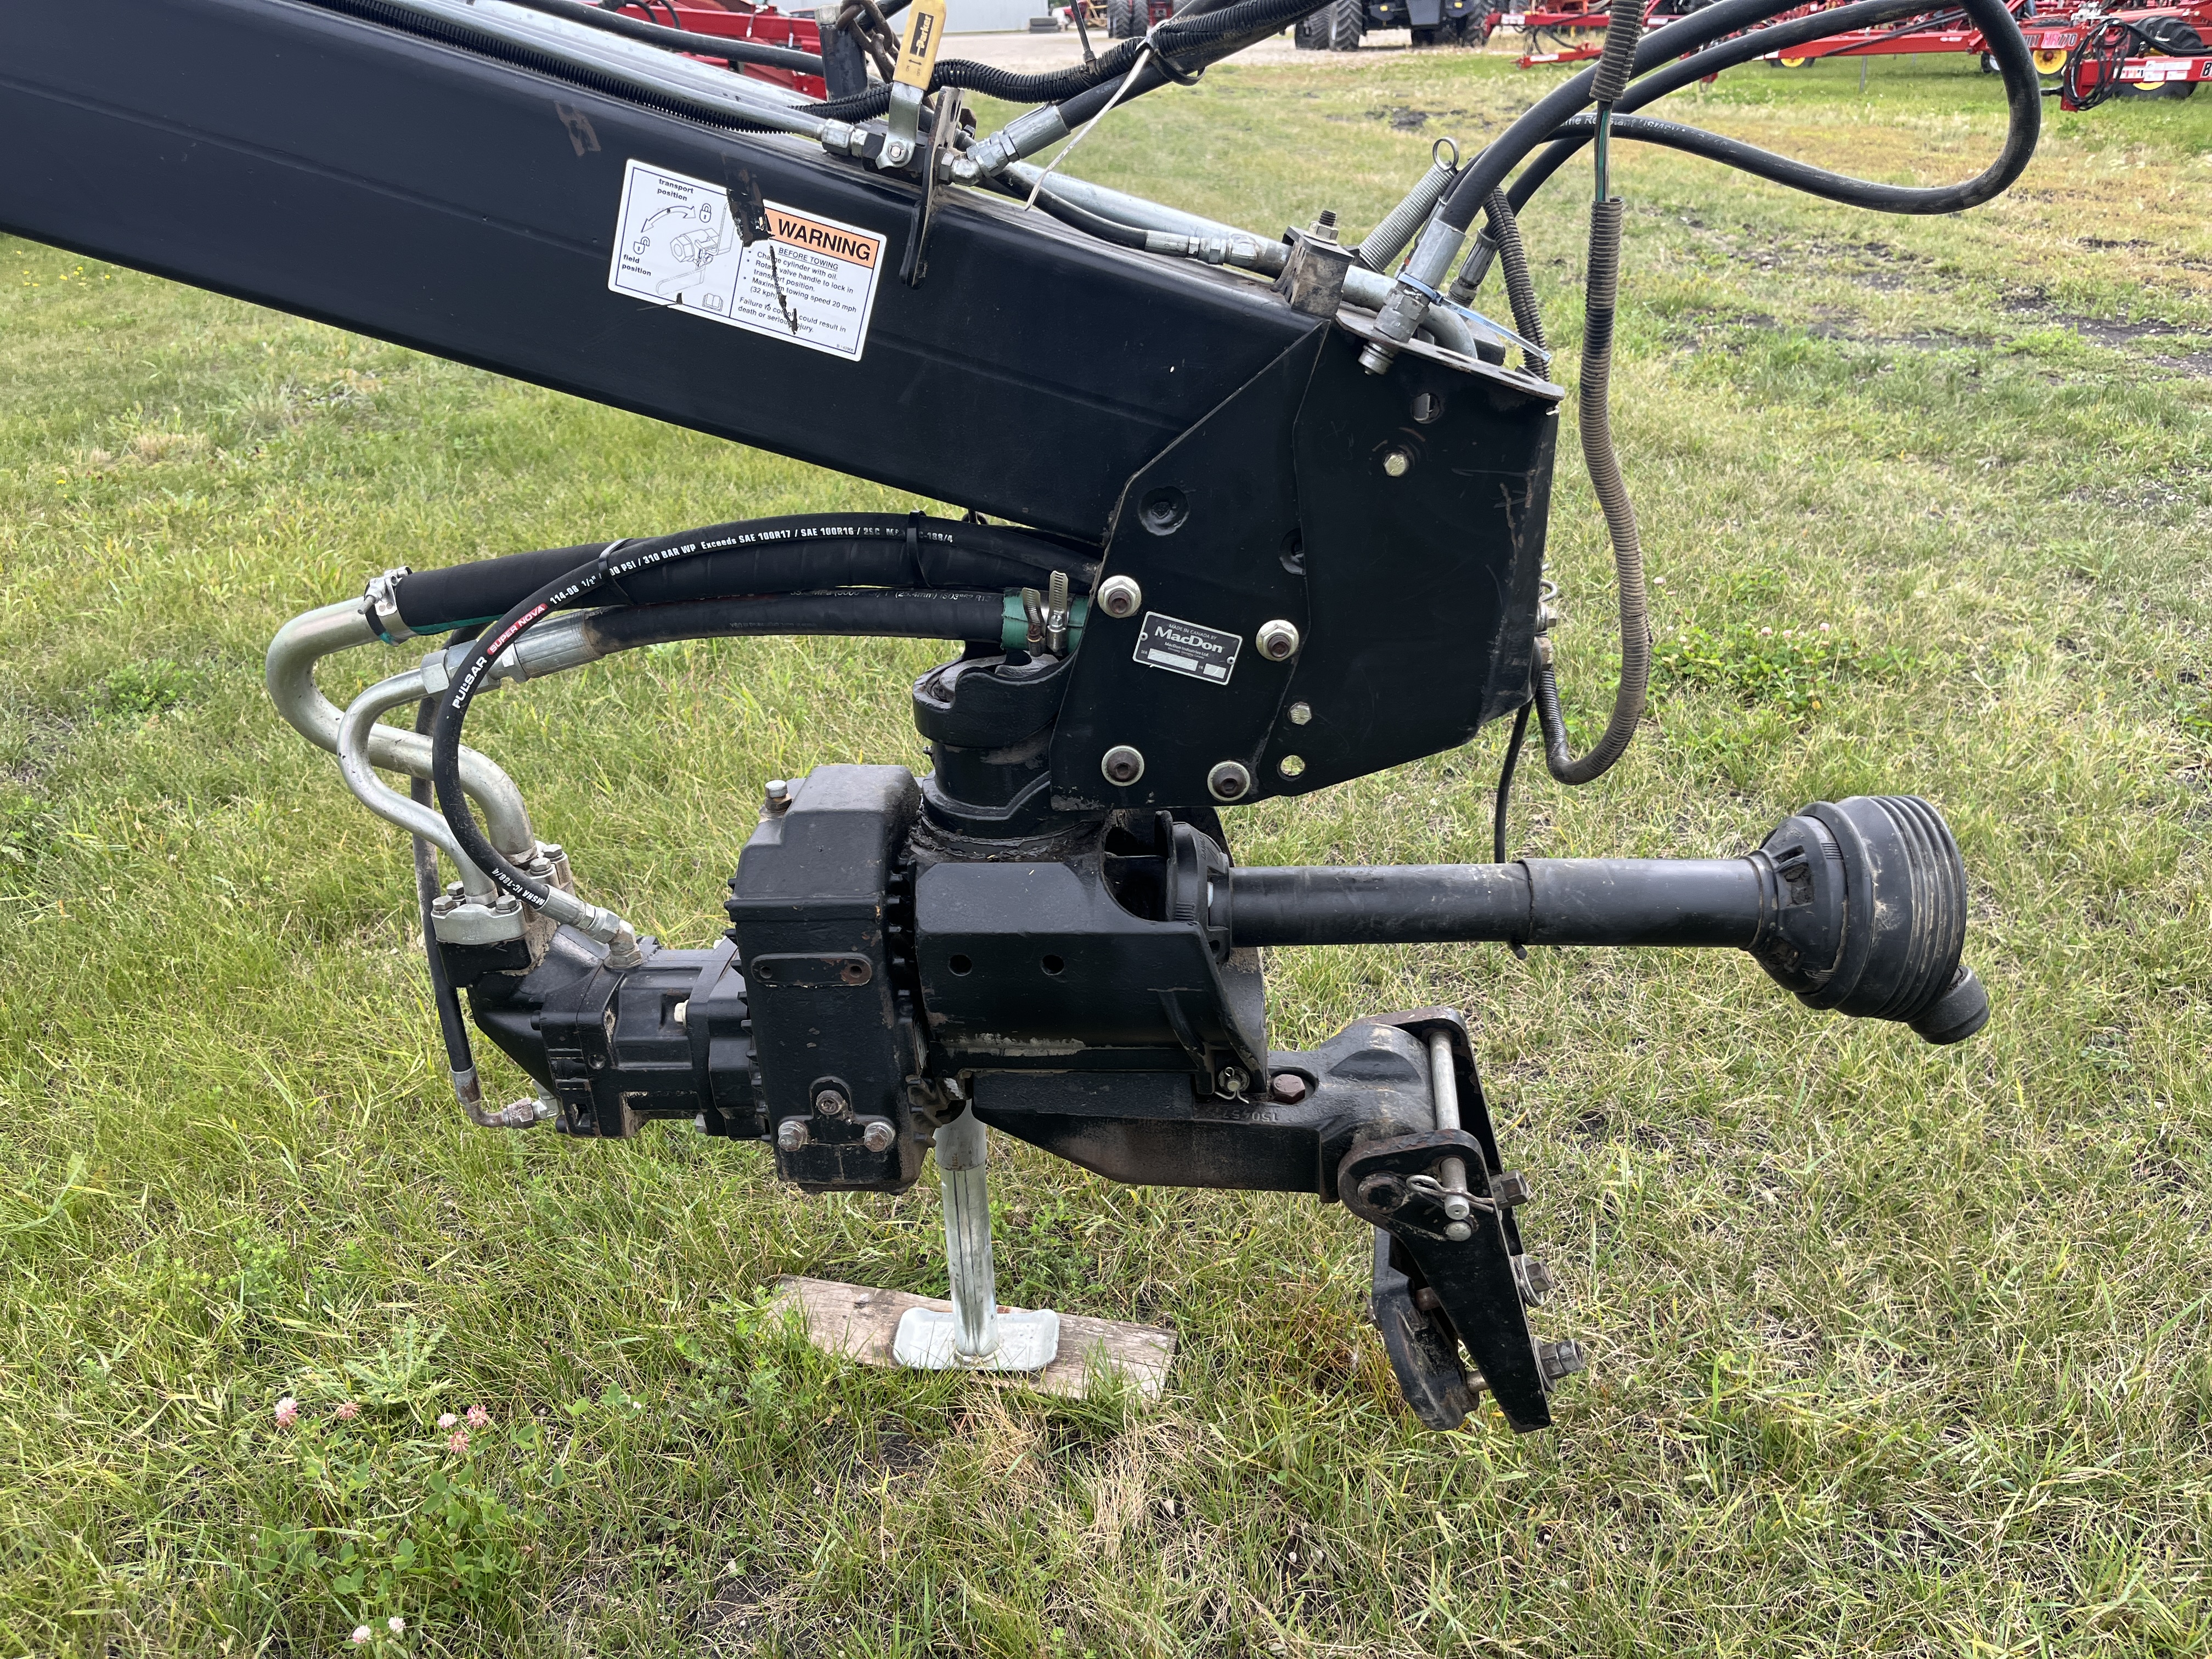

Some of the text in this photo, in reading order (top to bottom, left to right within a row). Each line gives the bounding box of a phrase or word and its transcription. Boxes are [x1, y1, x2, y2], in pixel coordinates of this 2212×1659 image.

[916, 15, 932, 56] Parker
[657, 188, 687, 201] position
[659, 178, 693, 194] transport
[778, 218, 871, 261] WARNING
[622, 263, 651, 276] position
[623, 254, 640, 263] field
[757, 251, 781, 263] Chage
[783, 260, 811, 272] cylinder
[812, 268, 826, 277] with
[779, 247, 838, 270] BEFORE TOWING
[752, 277, 785, 291] Maximm
[786, 287, 809, 300] towing
[810, 295, 831, 305] speed
[780, 268, 797, 277] valve
[799, 273, 821, 284] handle
[831, 282, 845, 292] lock
[786, 279, 815, 292] position.
[738, 306, 757, 316] death
[740, 297, 763, 308] Failure
[799, 315, 818, 325] could
[819, 321, 838, 331] result
[550, 585, 579, 604] 114-08
[582, 575, 596, 586] 1/2"
[620, 560, 636, 572] PSI
[642, 553, 660, 565] 310
[661, 548, 680, 558] BAR
[681, 544, 696, 554] WP
[701, 537, 737, 550] Exceeds
[738, 534, 757, 544] SAE
[758, 530, 791, 541] 100R17
[800, 528, 819, 537] SAE
[489, 605, 545, 654] SUPER NOVA
[1154, 625, 1223, 653] MacDon
[1190, 630, 1210, 639] CANADA
[1164, 641, 1181, 650] MacDon
[1181, 646, 1201, 655] Industries
[452, 656, 488, 709] PULSAR
[522, 890, 545, 906] MSHA
